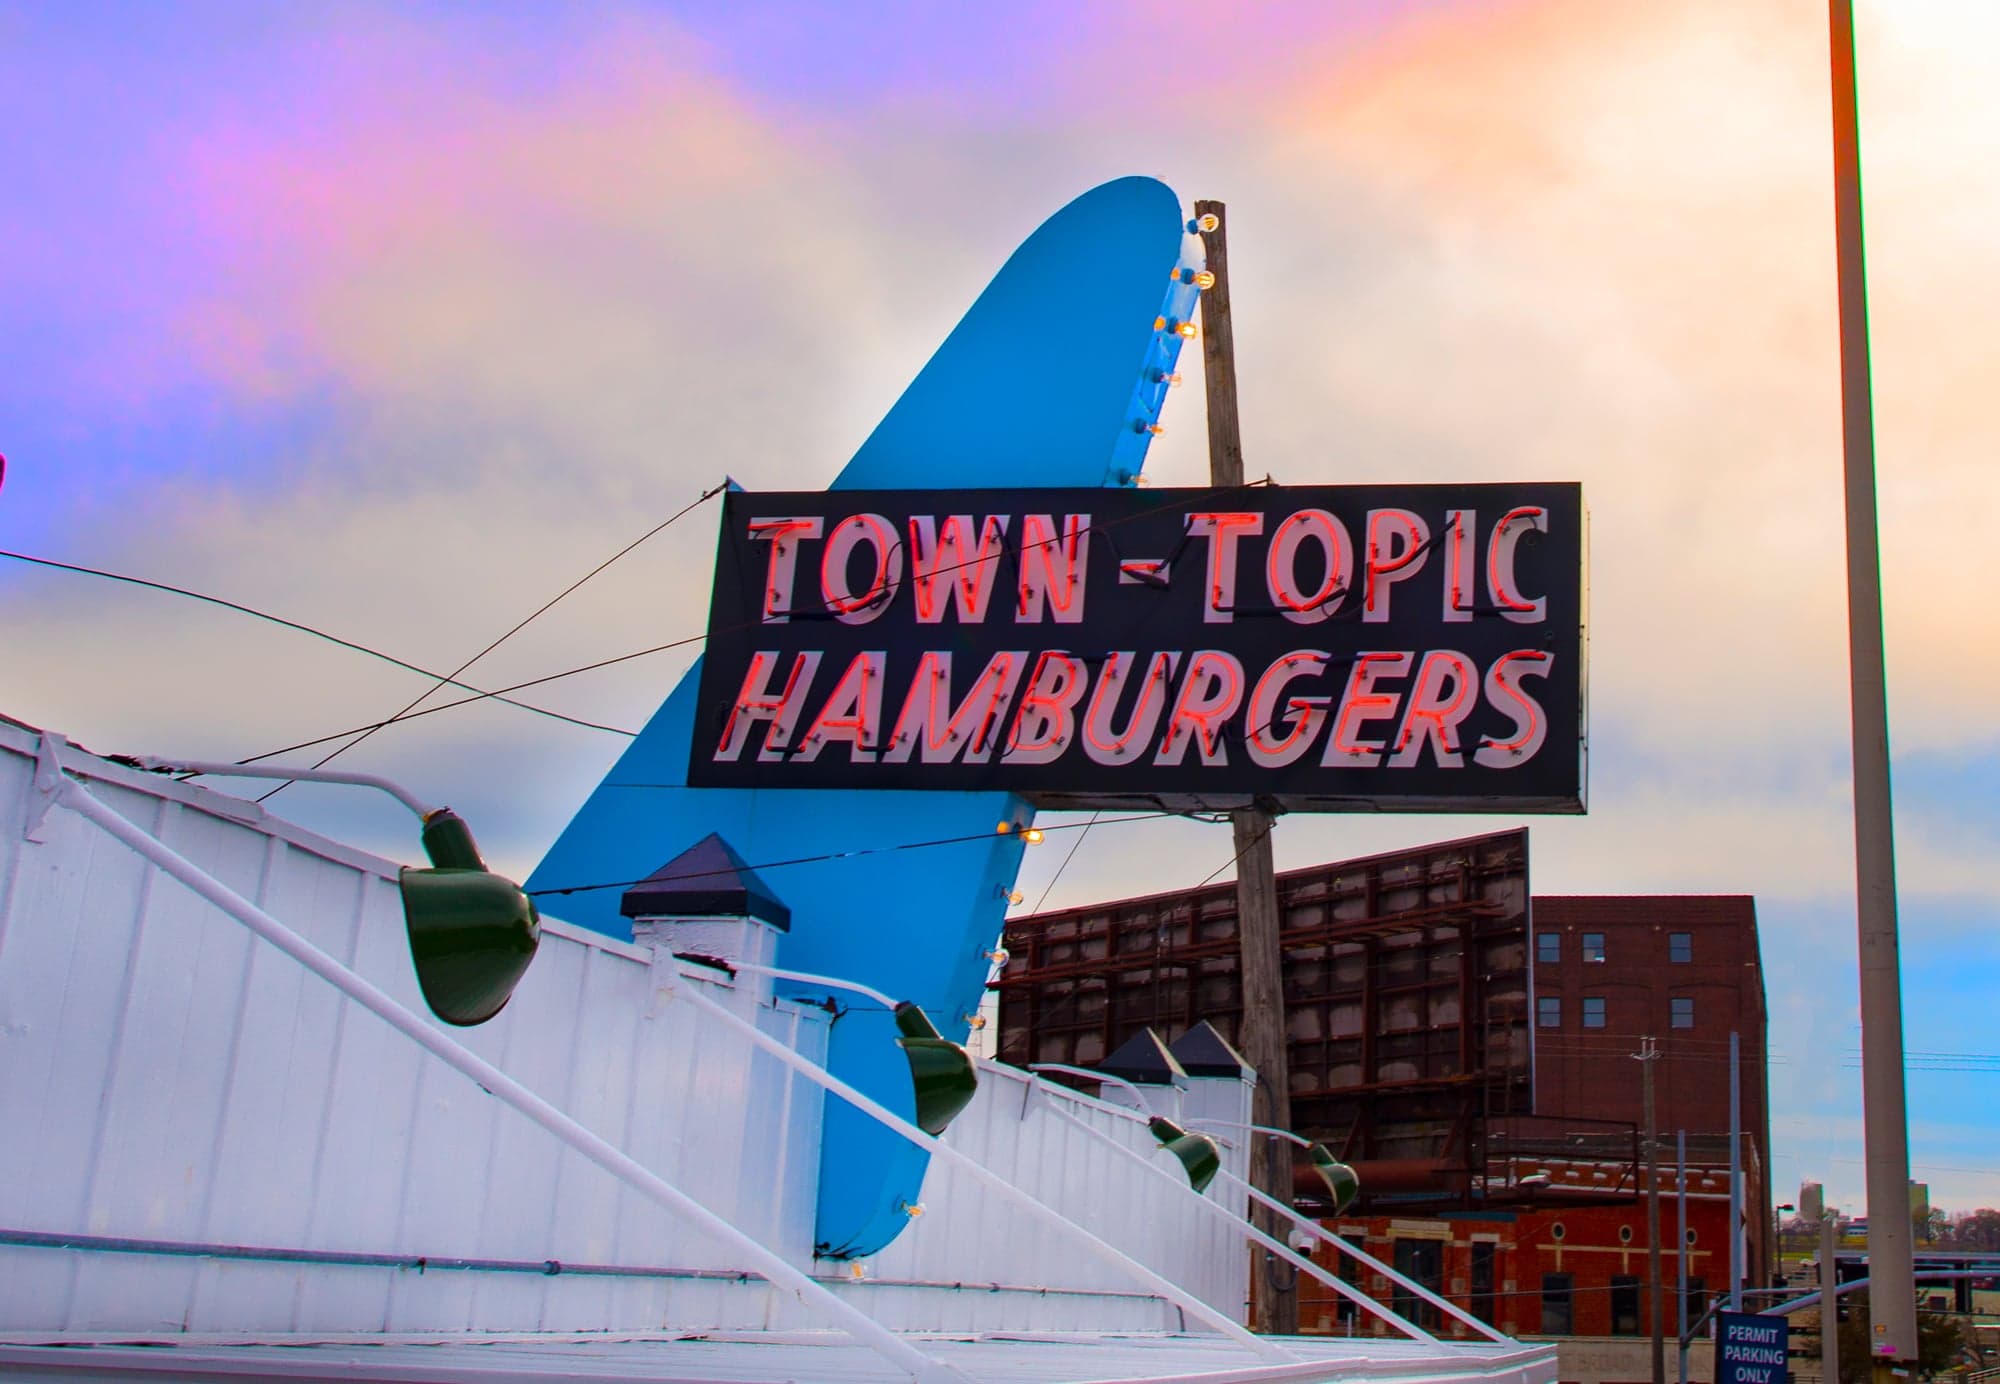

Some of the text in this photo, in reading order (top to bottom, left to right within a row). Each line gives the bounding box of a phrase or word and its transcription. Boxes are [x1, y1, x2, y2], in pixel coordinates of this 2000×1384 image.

[713, 648, 1556, 769] HAMBURGERS
[1728, 1325, 1779, 1344] PERMIT
[1724, 1345, 1785, 1366] PARKING
[1735, 1367, 1772, 1384] ONLY
